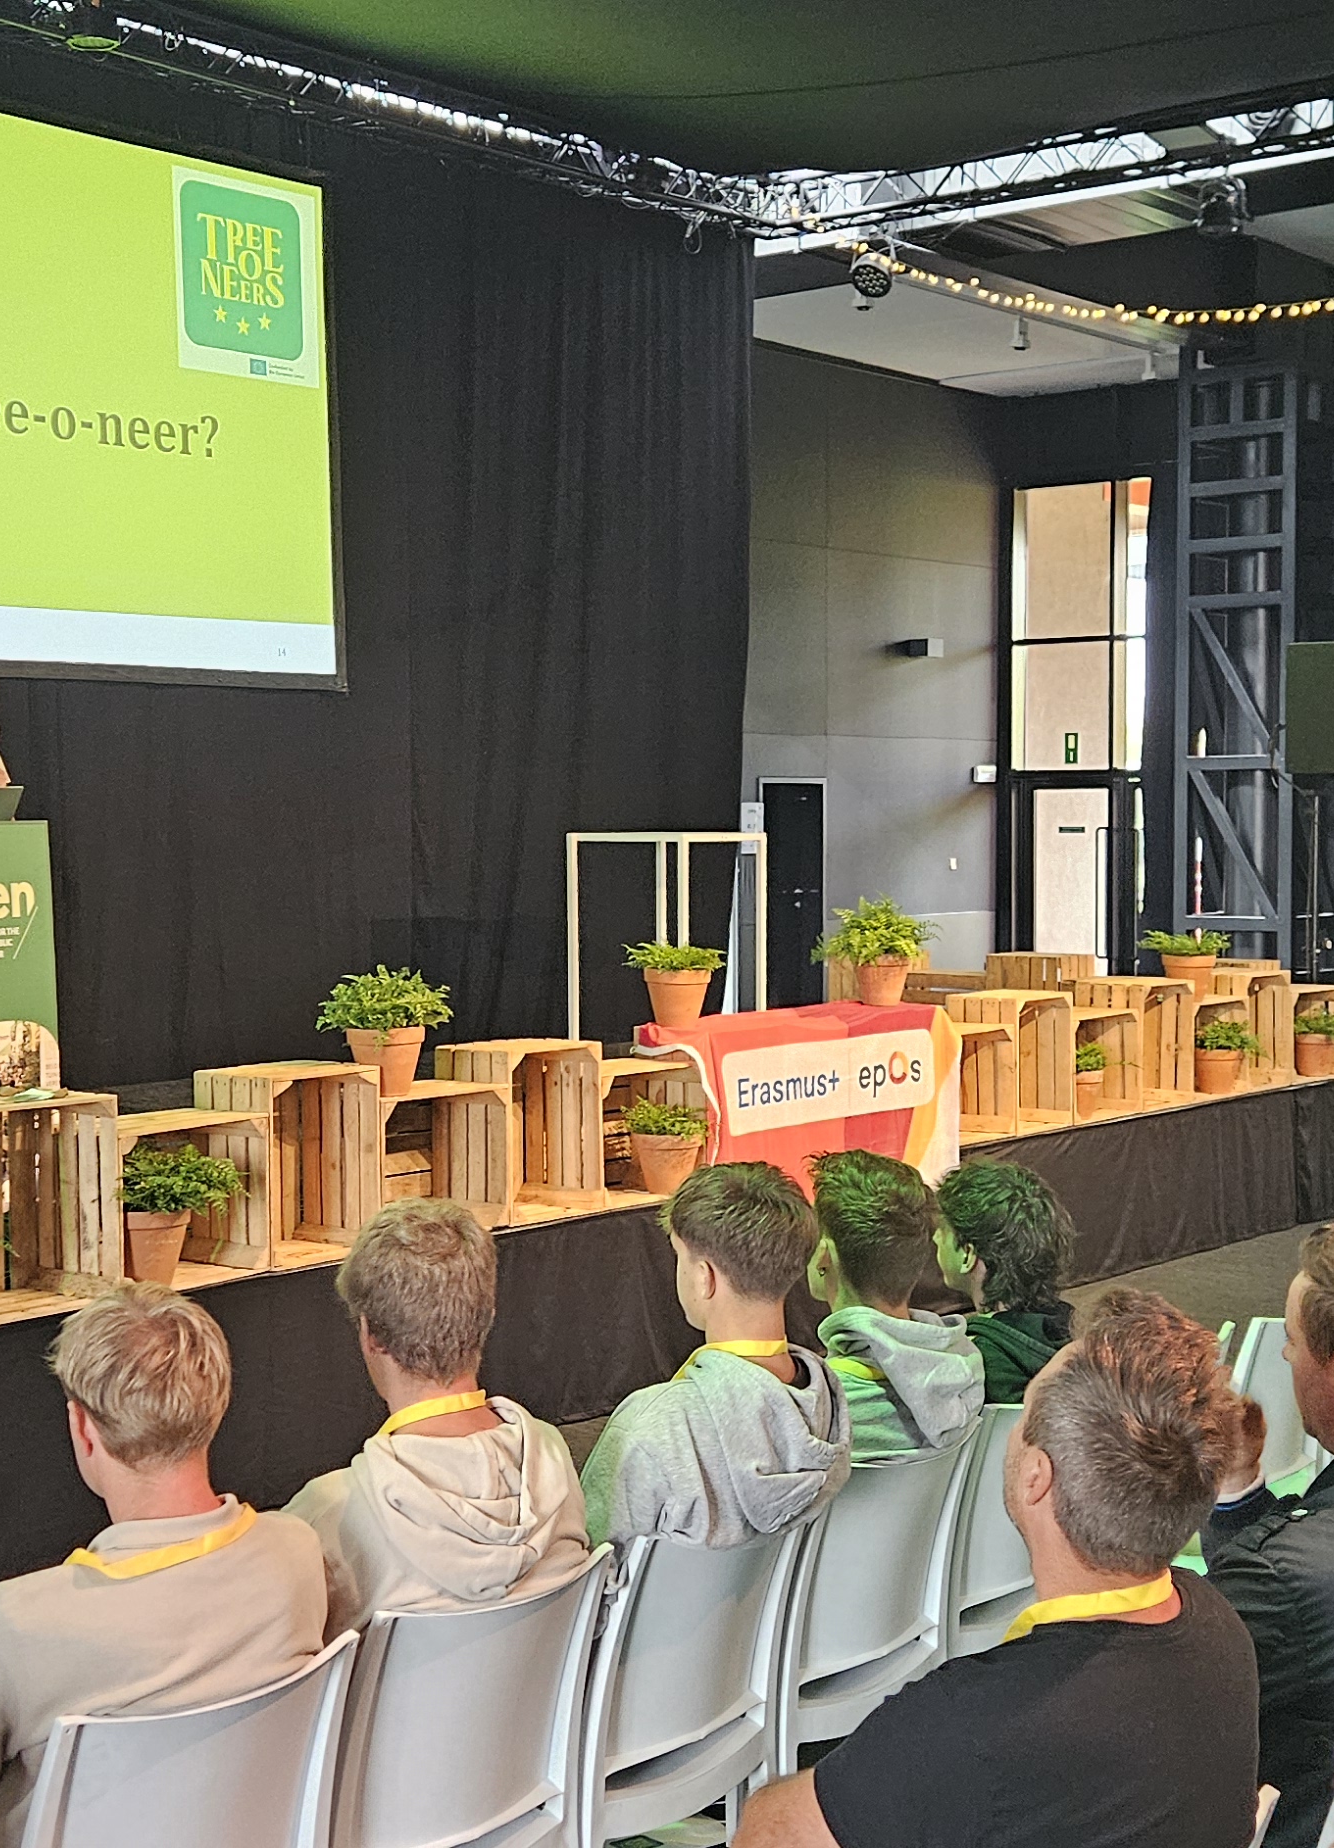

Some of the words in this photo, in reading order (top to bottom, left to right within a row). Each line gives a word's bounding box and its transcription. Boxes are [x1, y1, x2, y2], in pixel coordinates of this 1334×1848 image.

[197, 213, 284, 273] TREE
[200, 258, 285, 308] NEERS
[6, 927, 20, 936] THE
[738, 1069, 840, 1108] Erasmus+
